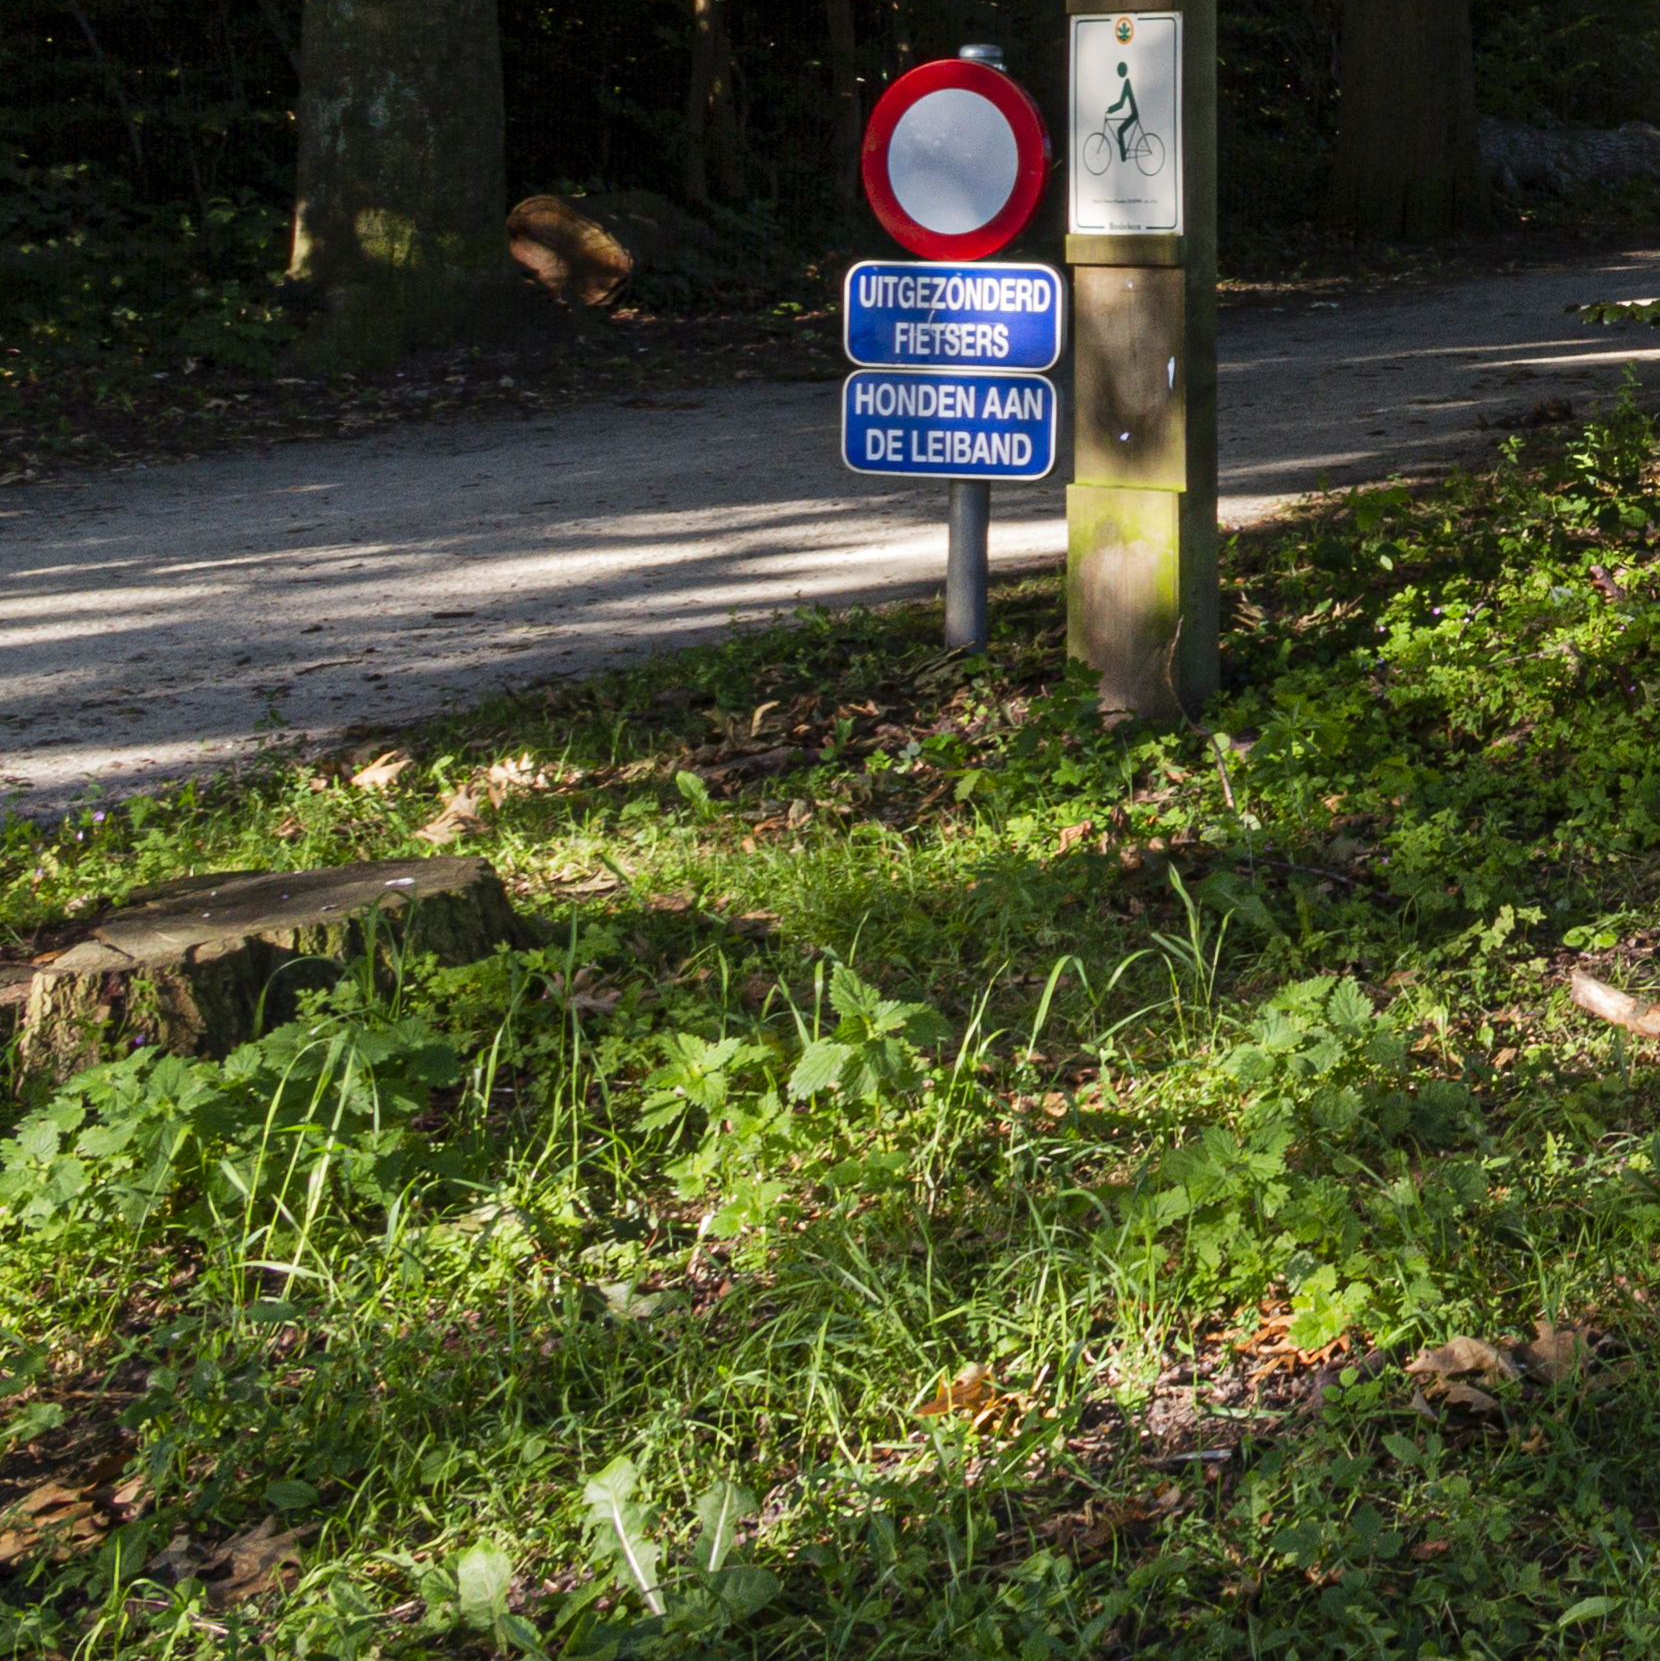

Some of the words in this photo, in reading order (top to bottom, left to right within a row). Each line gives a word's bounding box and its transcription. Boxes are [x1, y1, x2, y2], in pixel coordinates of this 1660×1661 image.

[859, 275, 1051, 312] UITGEZONDERD
[894, 322, 1009, 358] FIETSERS
[855, 383, 975, 418] HONDEN
[982, 387, 1043, 420] AAN
[865, 429, 904, 461] DE
[911, 430, 1032, 466] LEIBAND
